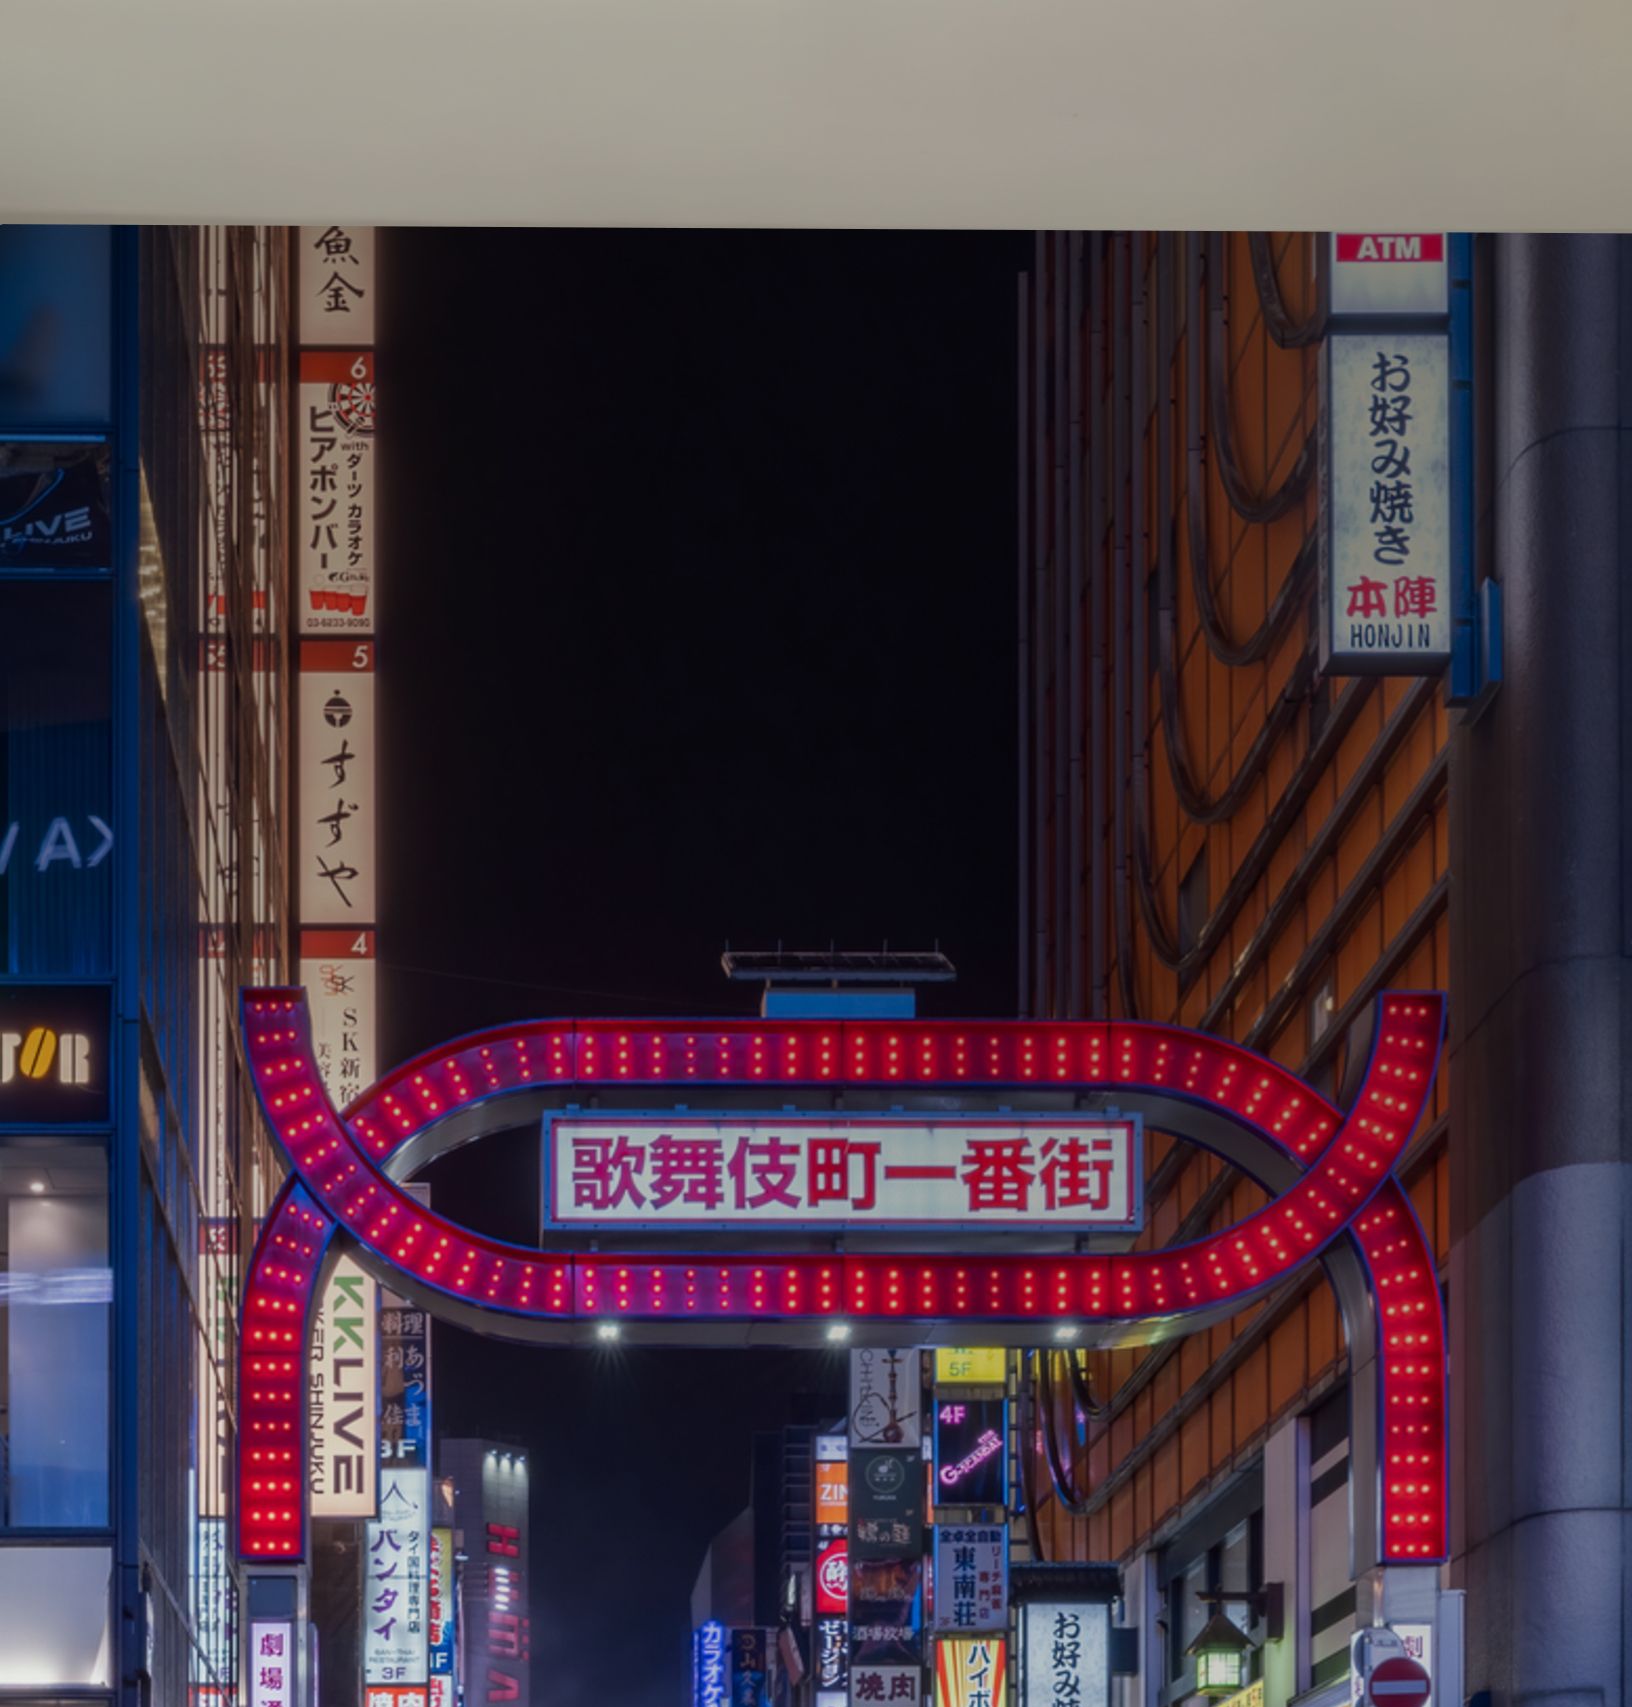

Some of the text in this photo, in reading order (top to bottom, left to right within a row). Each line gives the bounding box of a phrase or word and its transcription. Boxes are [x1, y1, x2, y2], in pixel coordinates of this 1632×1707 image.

[314, 226, 365, 313] 魚金
[1356, 235, 1422, 260] ATM
[350, 356, 367, 381] 6
[341, 440, 369, 452] with
[1369, 351, 1414, 567] お好み焼き
[309, 405, 339, 570] ビアポンバー
[347, 503, 363, 567] カラオケ
[1346, 575, 1438, 620] 本陣
[351, 646, 369, 669] 5
[1350, 623, 1431, 649] HONJIN
[317, 740, 359, 908] すずや
[351, 932, 368, 955] 4
[572, 1136, 1113, 1211] 歌舞伎町一番街
[333, 1276, 364, 1494] KKLIVE
[404, 1345, 425, 1427] あづま
[939, 1404, 966, 1425] 4F
[310, 1373, 325, 1495] SHINJUKU
[370, 1529, 401, 1641] バンタイ
[953, 1545, 977, 1627] 東南荘
[381, 1666, 407, 1680] 3F
[856, 1672, 915, 1702] 焼肉
